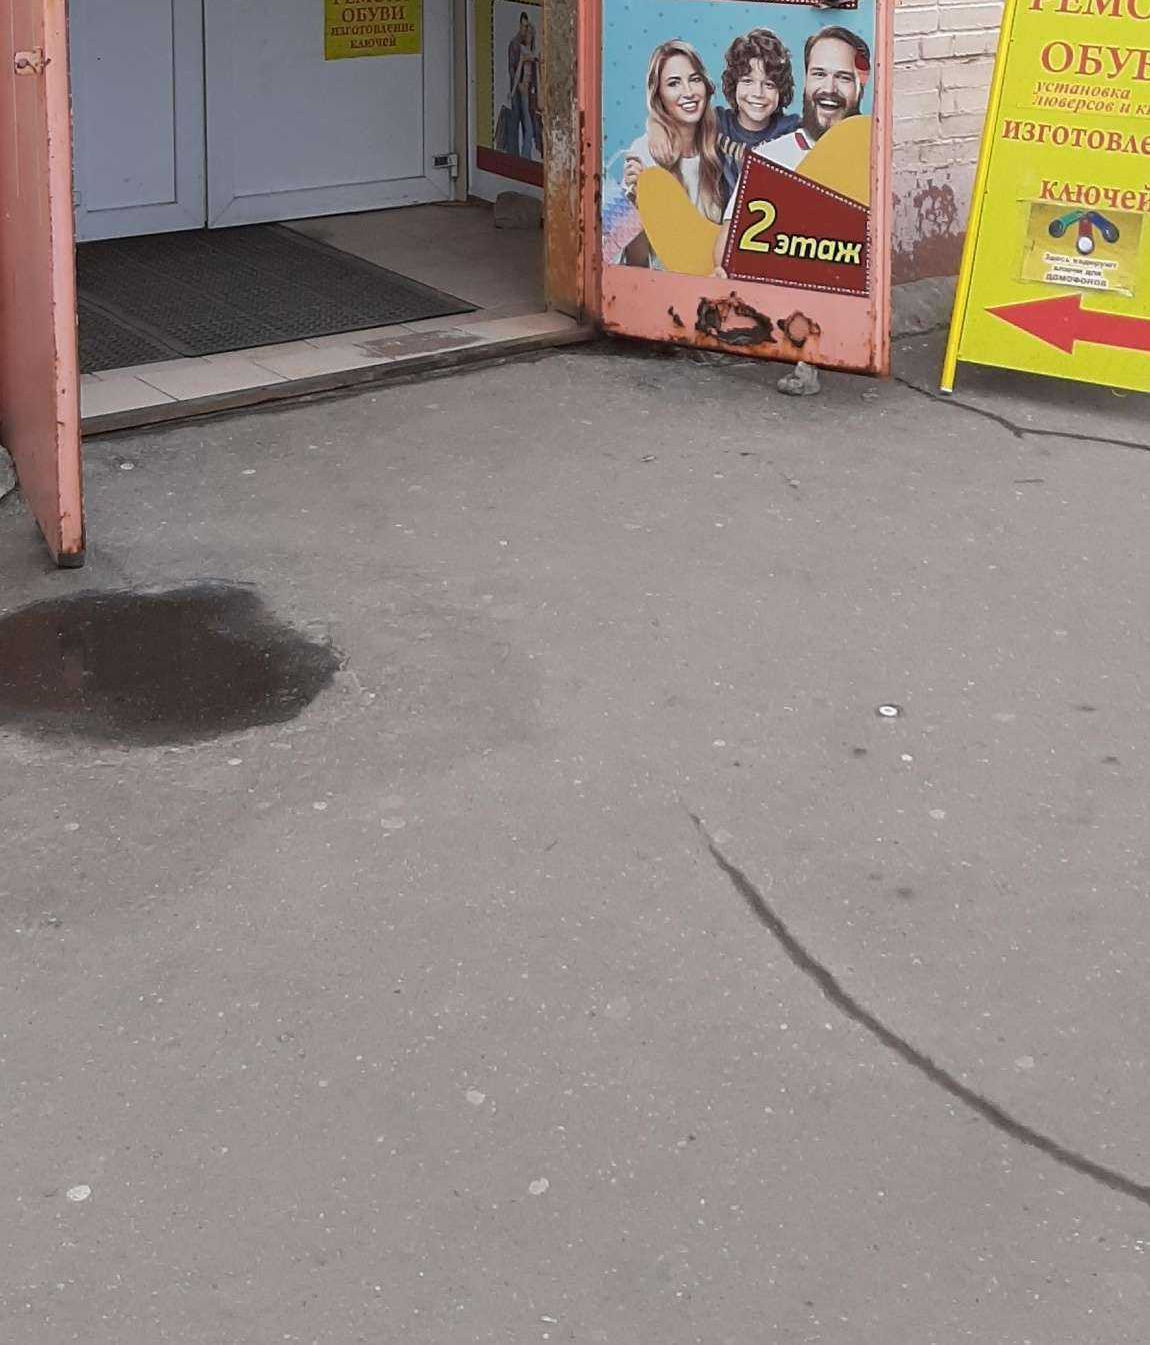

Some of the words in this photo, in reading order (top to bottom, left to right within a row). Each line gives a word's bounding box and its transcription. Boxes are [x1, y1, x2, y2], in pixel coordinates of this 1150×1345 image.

[342, 6, 406, 23] ОБУВИ
[1033, 80, 1131, 100] установка
[1032, 96, 1115, 113] люверсов
[1119, 102, 1131, 114] и
[740, 200, 775, 251] 2
[774, 235, 861, 265] этаж
